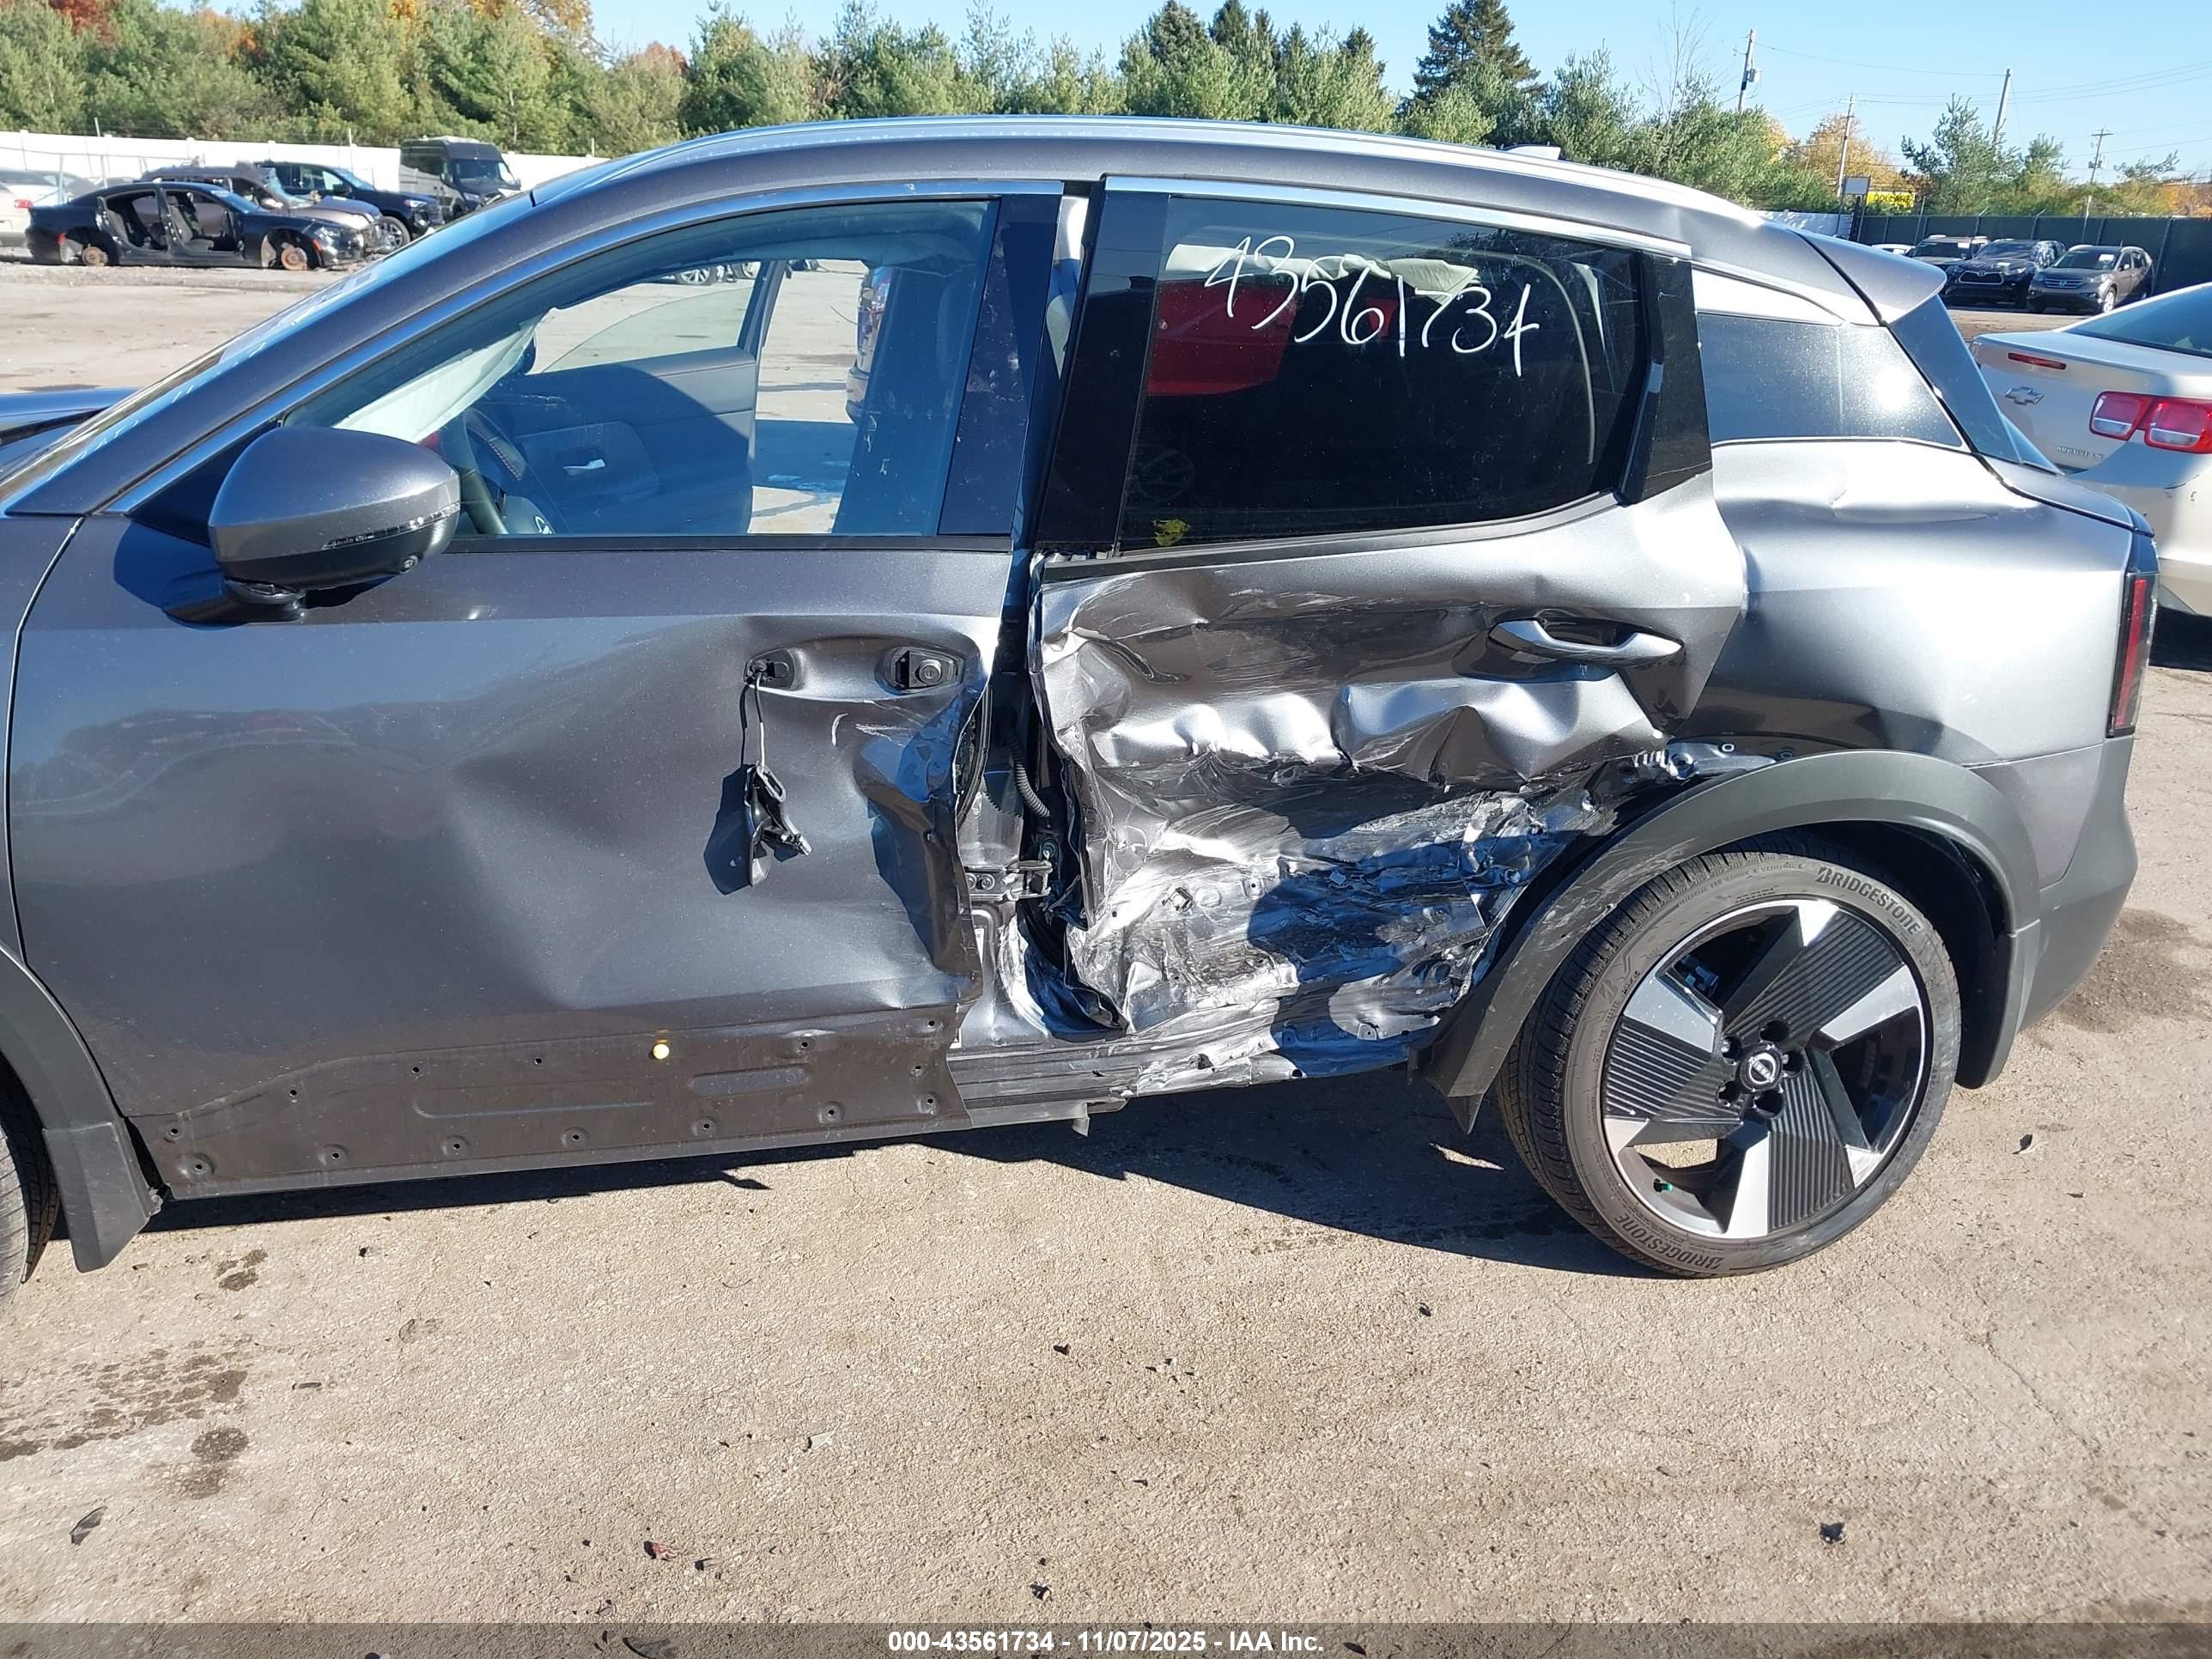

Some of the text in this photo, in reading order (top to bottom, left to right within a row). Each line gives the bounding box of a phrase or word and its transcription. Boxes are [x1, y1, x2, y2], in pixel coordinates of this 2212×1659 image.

[1205, 236, 1539, 377] 43561734
[1814, 866, 1921, 935] BRIDGESTONE
[1614, 1212, 1725, 1270] BRIDGESTONE
